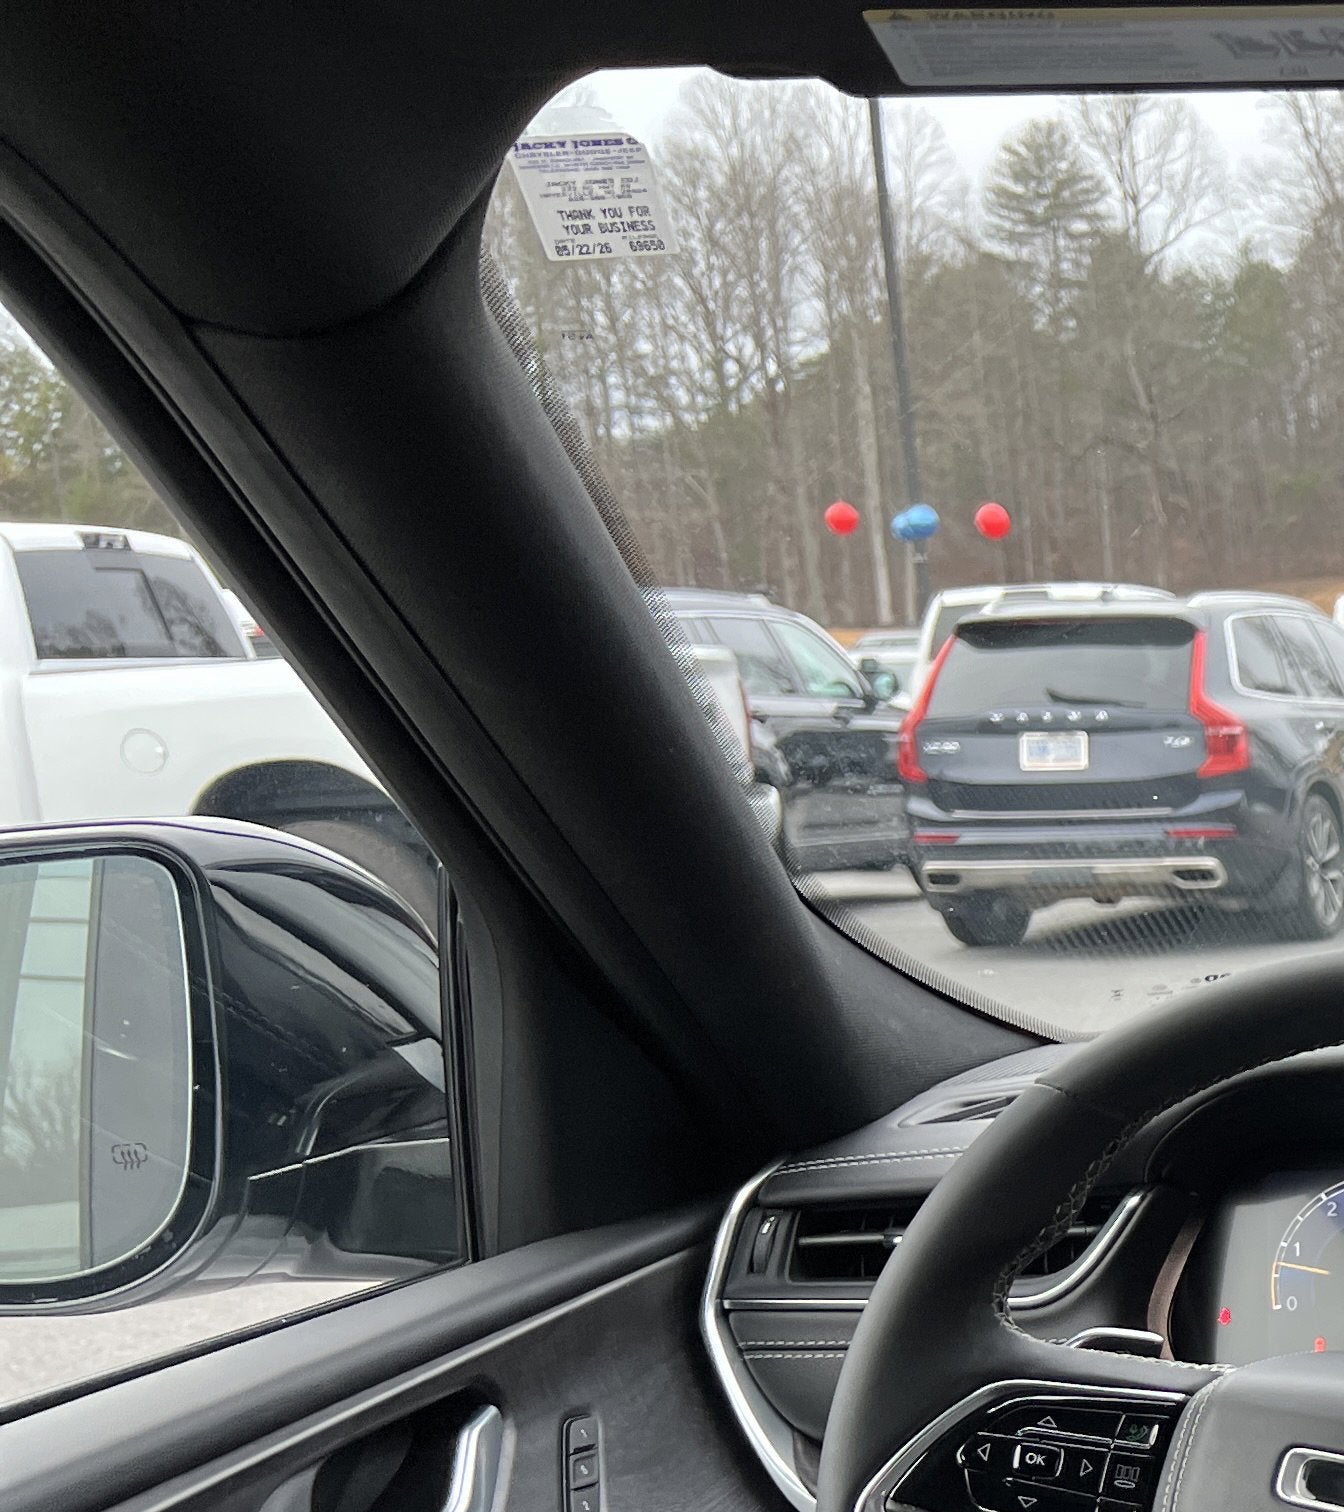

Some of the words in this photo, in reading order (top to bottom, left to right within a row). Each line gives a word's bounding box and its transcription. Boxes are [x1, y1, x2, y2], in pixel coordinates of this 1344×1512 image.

[556, 208, 595, 220] THANK
[600, 207, 623, 219] YOU
[627, 205, 651, 217] FOR
[562, 223, 594, 235] YOUR
[597, 220, 656, 234] BUSINESS
[1326, 1202, 1339, 1217] 2
[1293, 1242, 1301, 1257] 1
[1286, 1296, 1298, 1311] 0
[1025, 1452, 1047, 1466] OK
